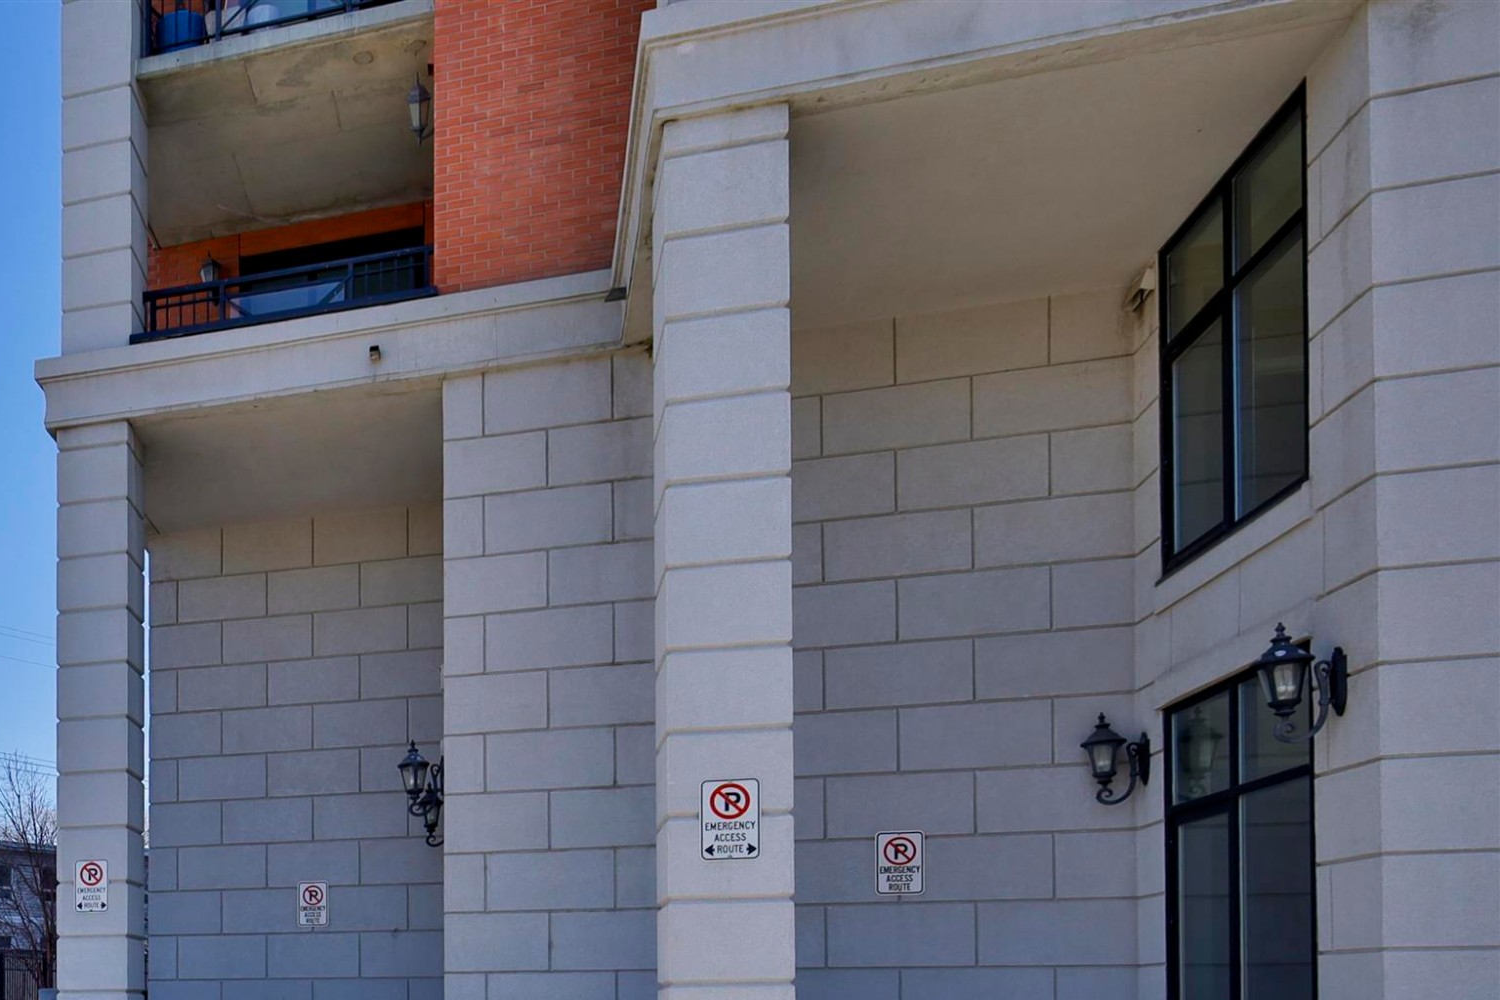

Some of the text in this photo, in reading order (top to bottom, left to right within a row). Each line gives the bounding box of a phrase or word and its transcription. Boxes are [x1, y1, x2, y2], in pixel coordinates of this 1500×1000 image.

[704, 821, 756, 831] EMERGENCY
[714, 832, 747, 842] ACCESS
[717, 844, 744, 853] ROUTE
[879, 865, 920, 874] EMERGENCY
[886, 874, 914, 882] ACCESS
[888, 883, 911, 891] ROUTE
